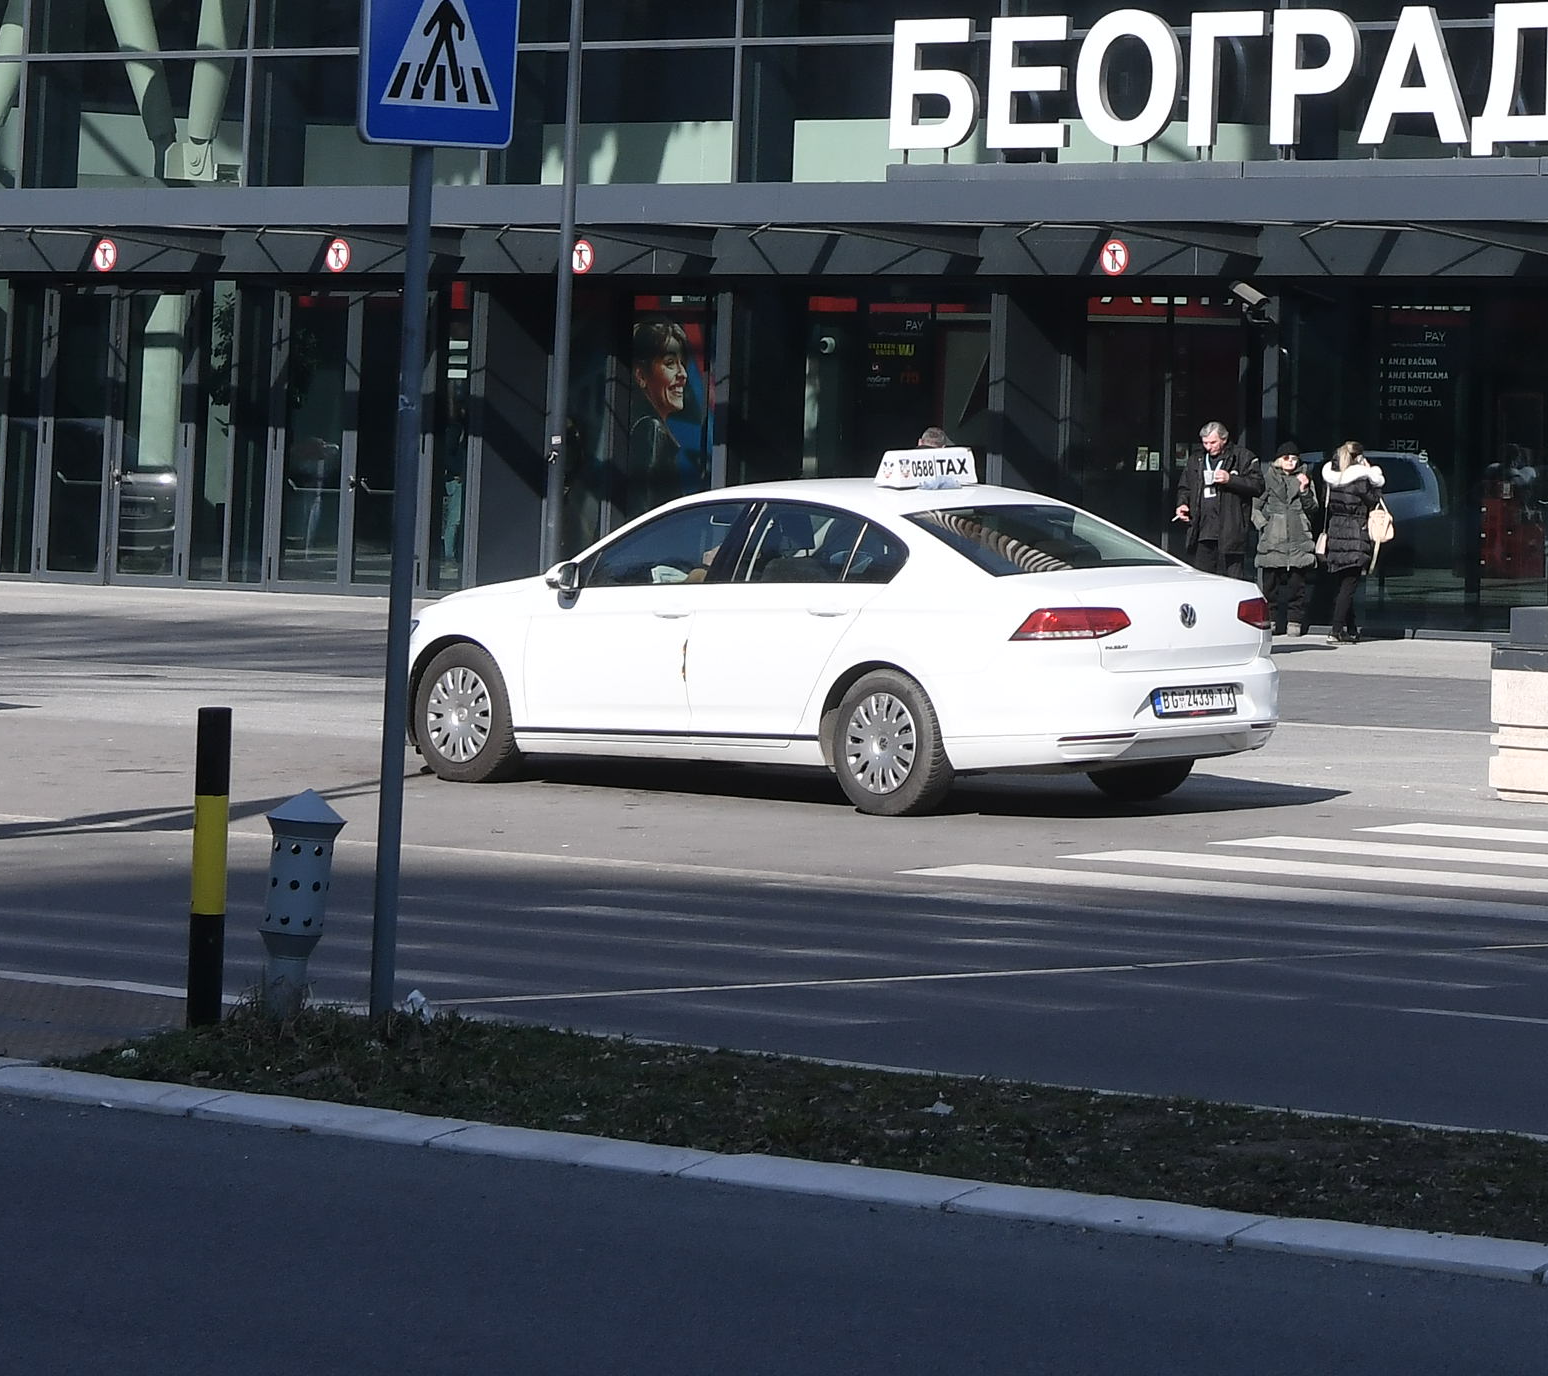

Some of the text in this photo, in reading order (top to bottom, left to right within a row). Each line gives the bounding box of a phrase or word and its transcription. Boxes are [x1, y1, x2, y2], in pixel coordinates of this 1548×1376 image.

[905, 320, 923, 331] PAY
[1425, 331, 1446, 342] PAY
[911, 459, 934, 477] 0588
[1162, 691, 1179, 709] BG
